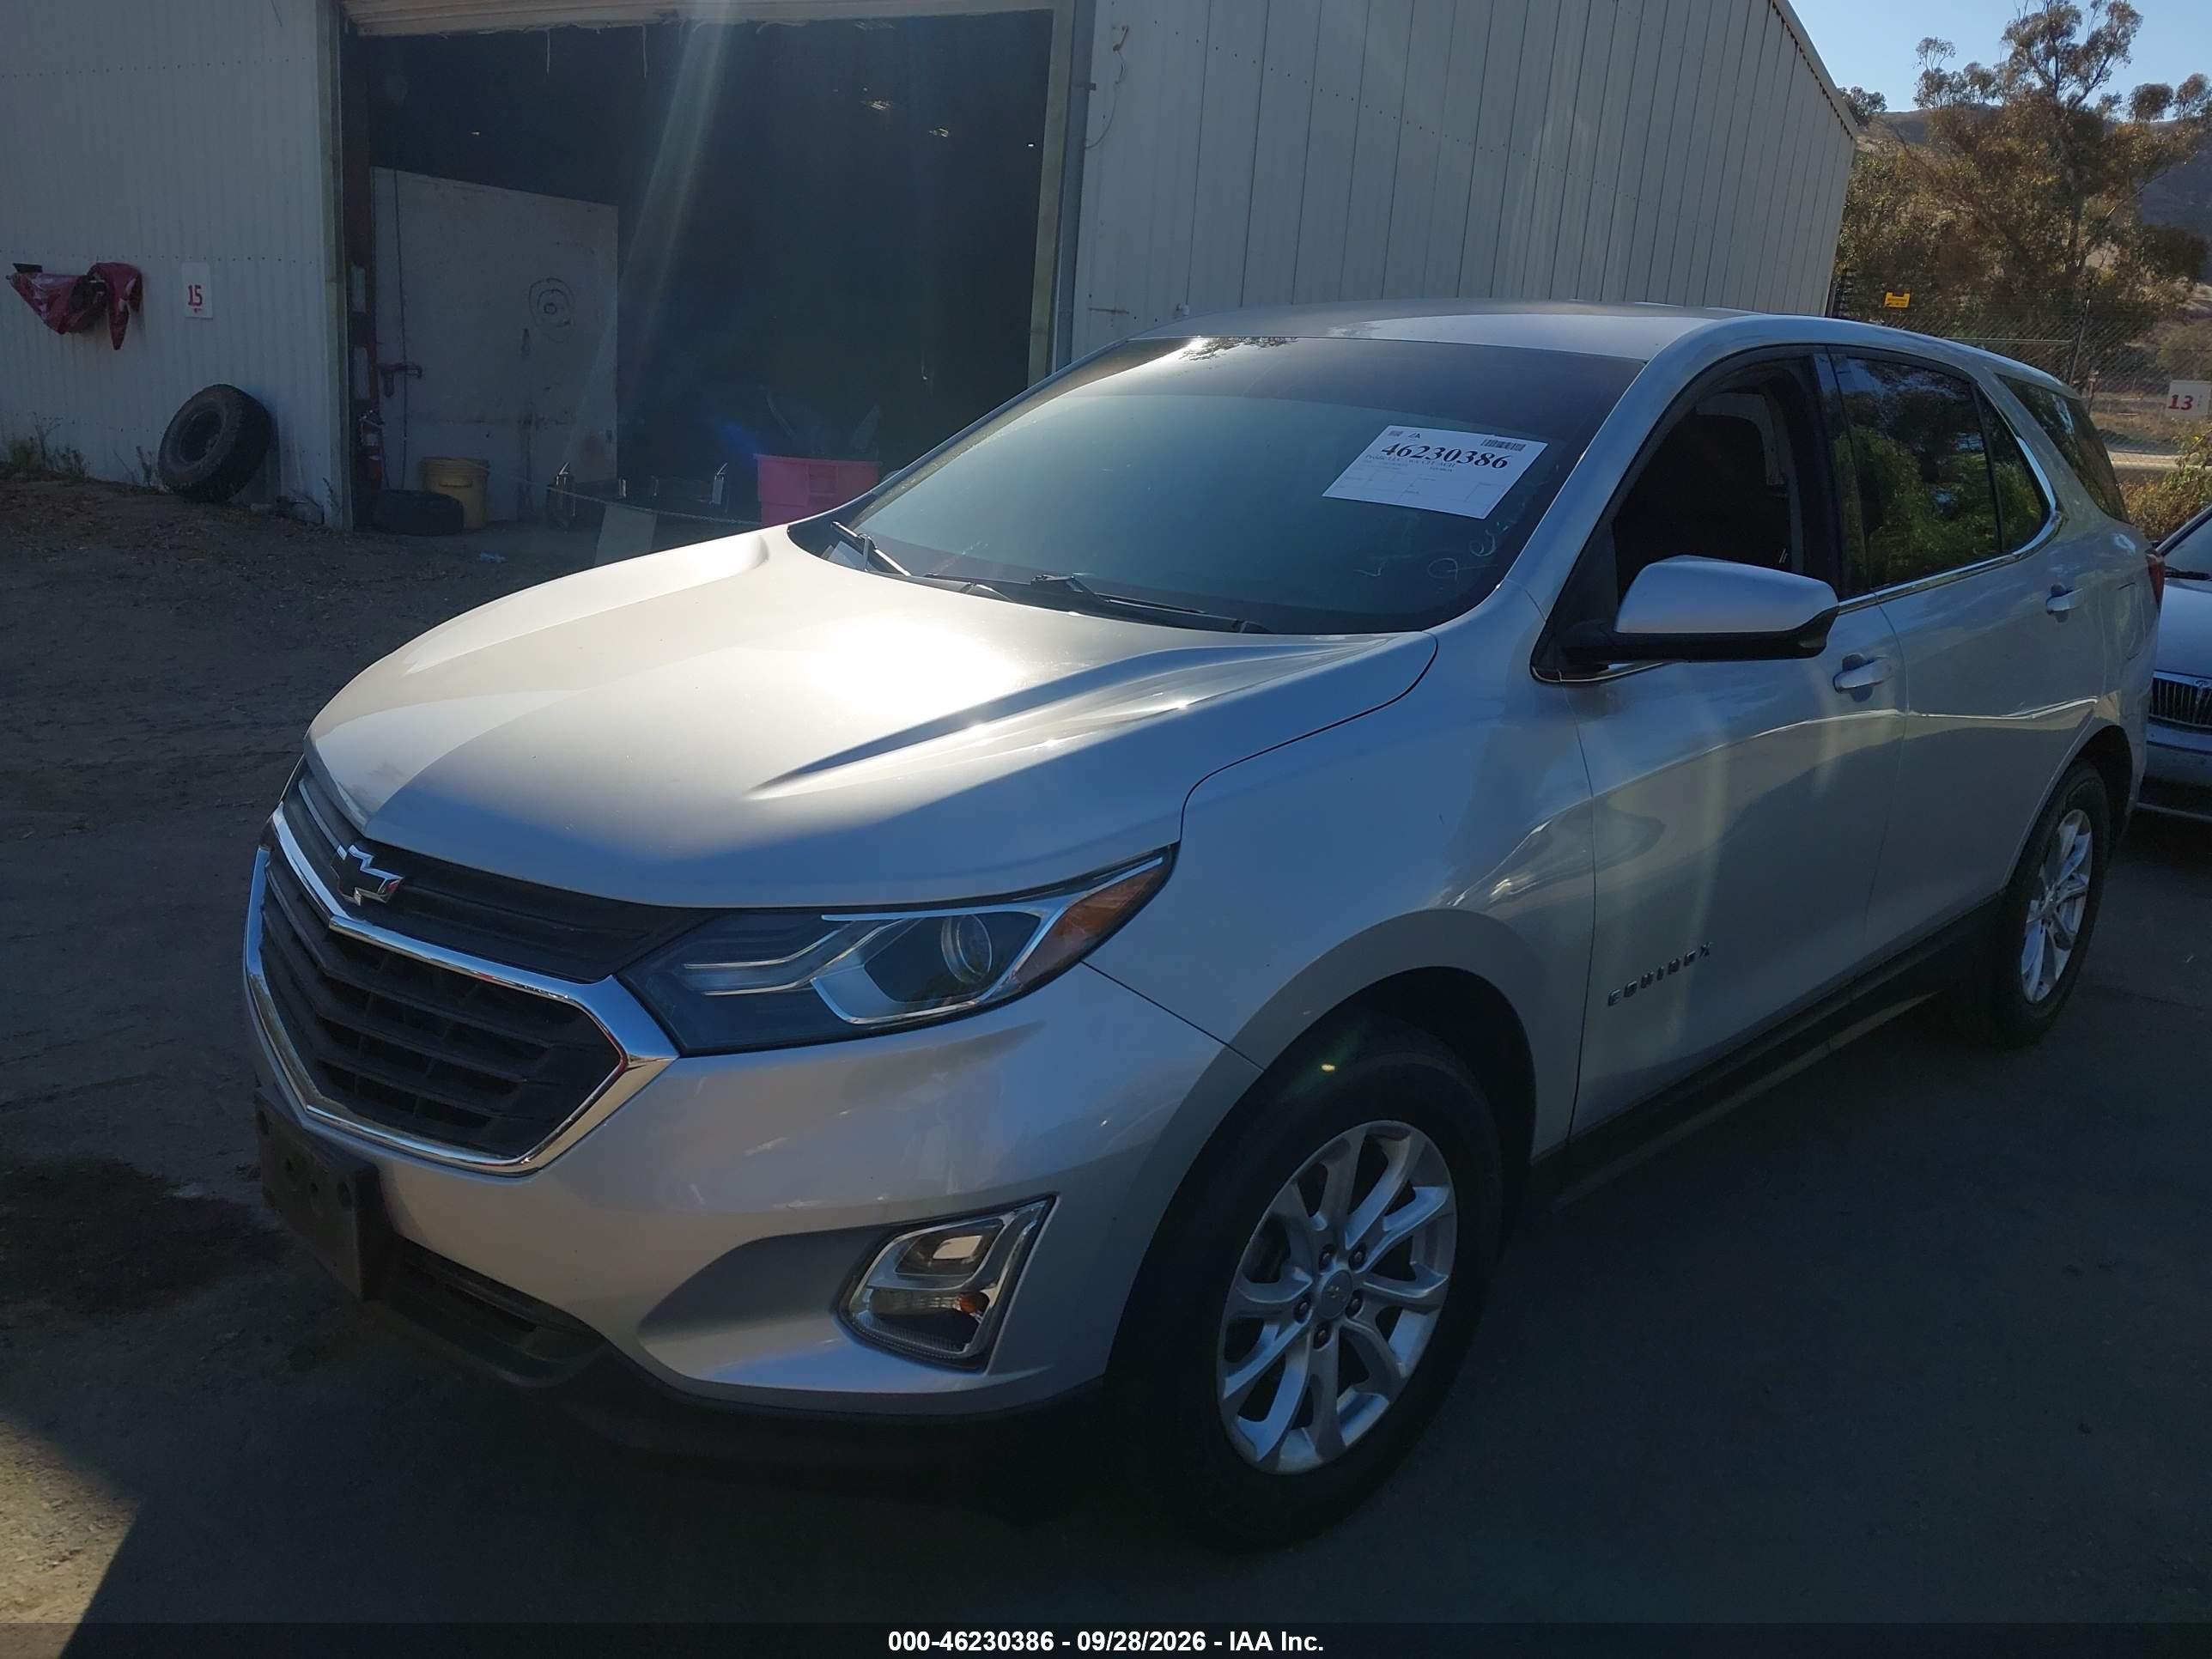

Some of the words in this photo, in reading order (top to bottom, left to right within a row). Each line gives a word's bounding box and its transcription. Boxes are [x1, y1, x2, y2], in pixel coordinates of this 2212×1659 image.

[187, 284, 203, 307] 15
[2168, 394, 2194, 410] 13
[1381, 442, 1512, 470] 46230386
[1607, 941, 1712, 1007] EQUINOX
